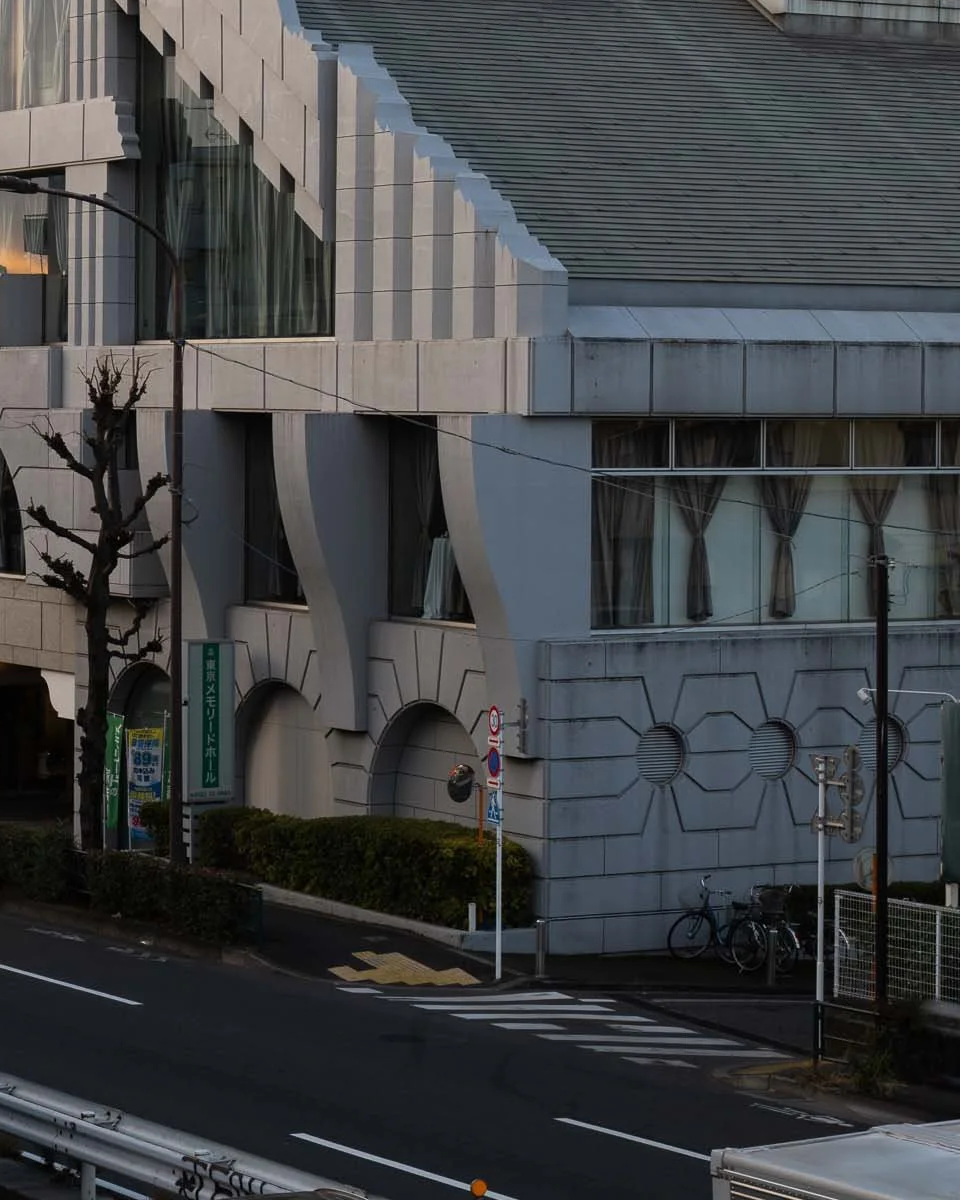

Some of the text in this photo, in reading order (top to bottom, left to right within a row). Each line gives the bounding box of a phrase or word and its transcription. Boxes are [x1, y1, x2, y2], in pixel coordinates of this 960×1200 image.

[205, 659, 218, 784] 東京メモリードホール
